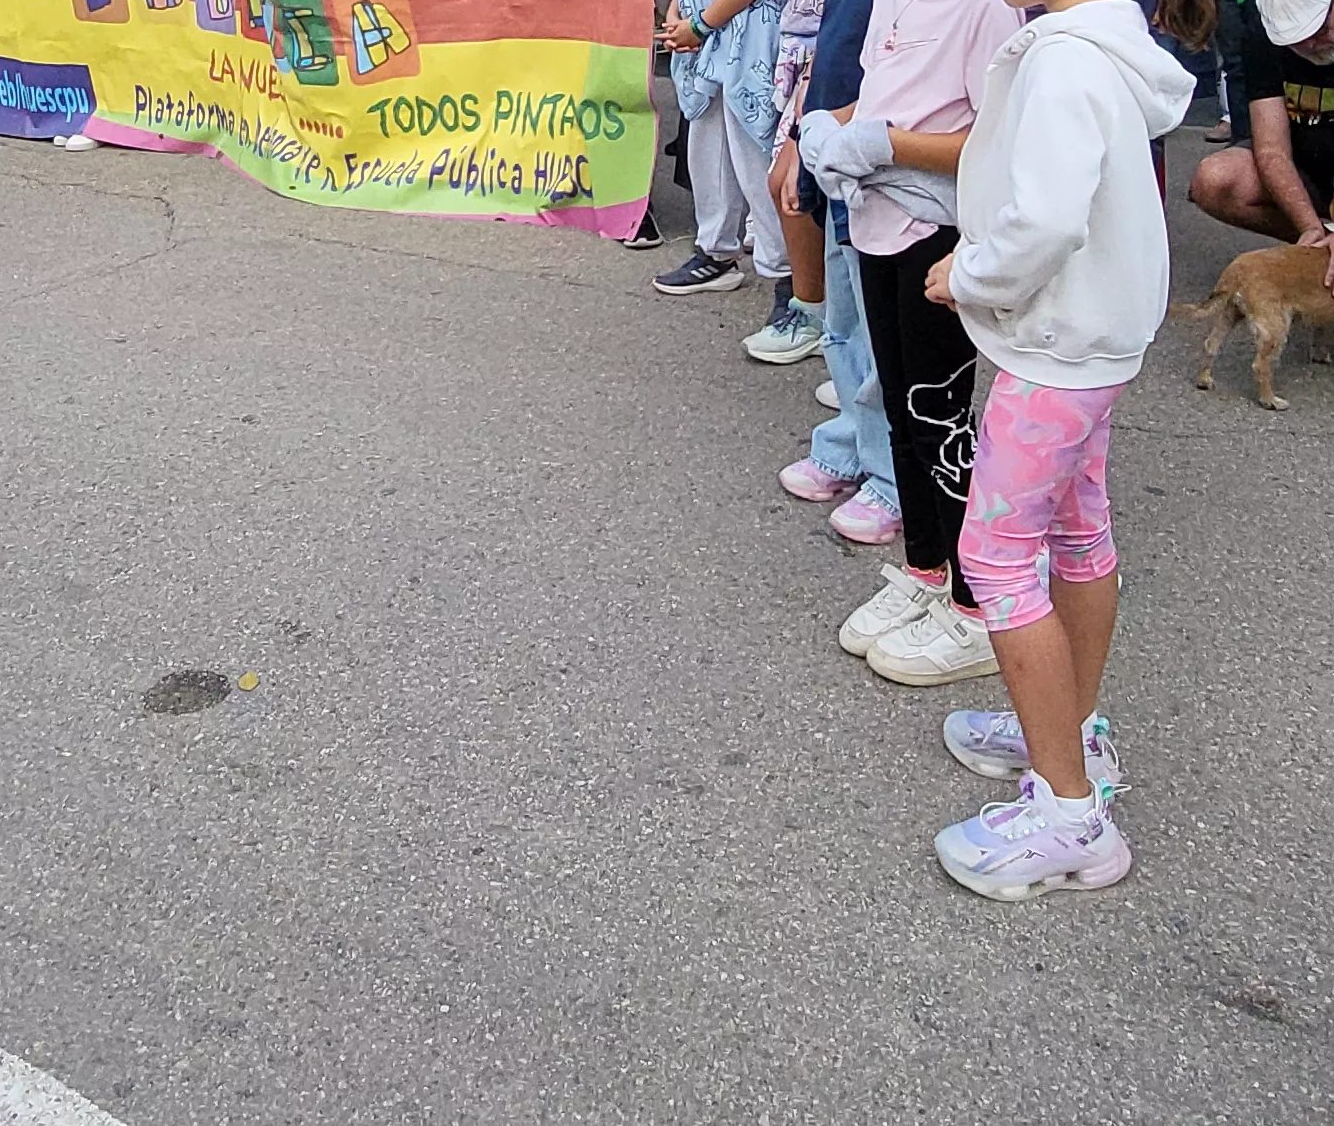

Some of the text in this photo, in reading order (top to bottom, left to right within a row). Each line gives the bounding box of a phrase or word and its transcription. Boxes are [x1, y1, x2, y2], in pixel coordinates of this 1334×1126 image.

[209, 48, 286, 102] LA NUE
[134, 84, 235, 137] Plataforma
[367, 90, 625, 141] TODOS PINTAOS
[343, 150, 424, 194] Escuela
[428, 145, 523, 197] Pública
